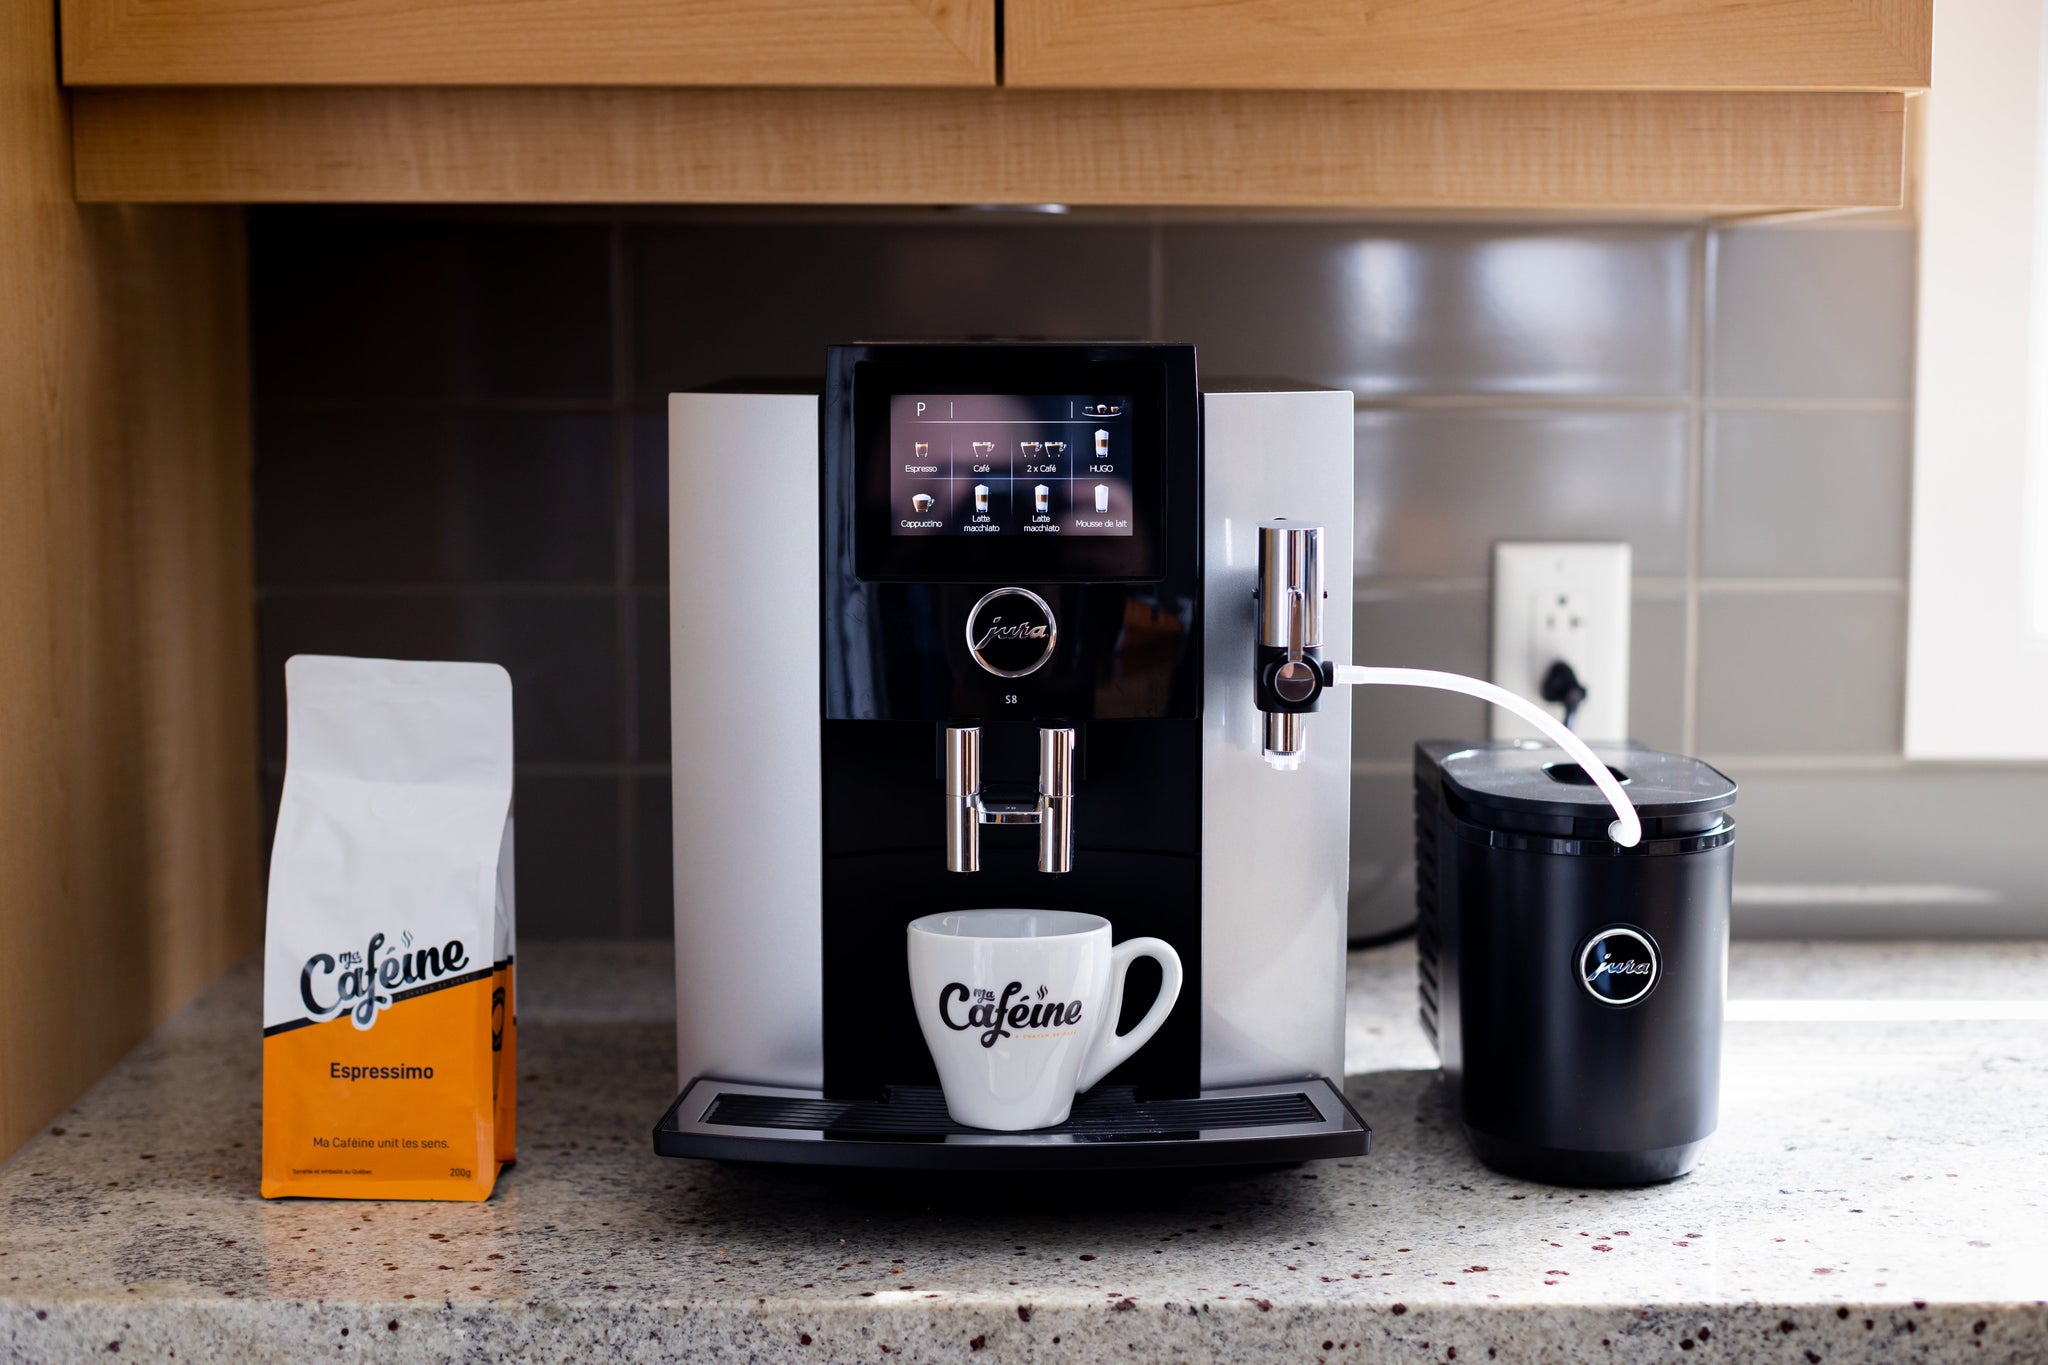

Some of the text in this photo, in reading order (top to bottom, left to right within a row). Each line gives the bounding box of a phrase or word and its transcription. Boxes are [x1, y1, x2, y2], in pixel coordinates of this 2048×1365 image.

[917, 402, 926, 416] P
[905, 465, 937, 474] Espresso
[973, 464, 990, 472] Café
[1040, 464, 1056, 472] Café
[901, 520, 942, 528] Cappuccino
[974, 616, 1048, 651] jura
[1005, 695, 1017, 704] S8
[1586, 953, 1651, 981] jura
[300, 933, 469, 1025] Caféine
[939, 981, 1082, 1048] Caféine
[330, 1062, 434, 1082] Espressimo
[313, 1137, 449, 1148] Ma Caféine unit les sens.
[450, 1168, 471, 1178] 200g
